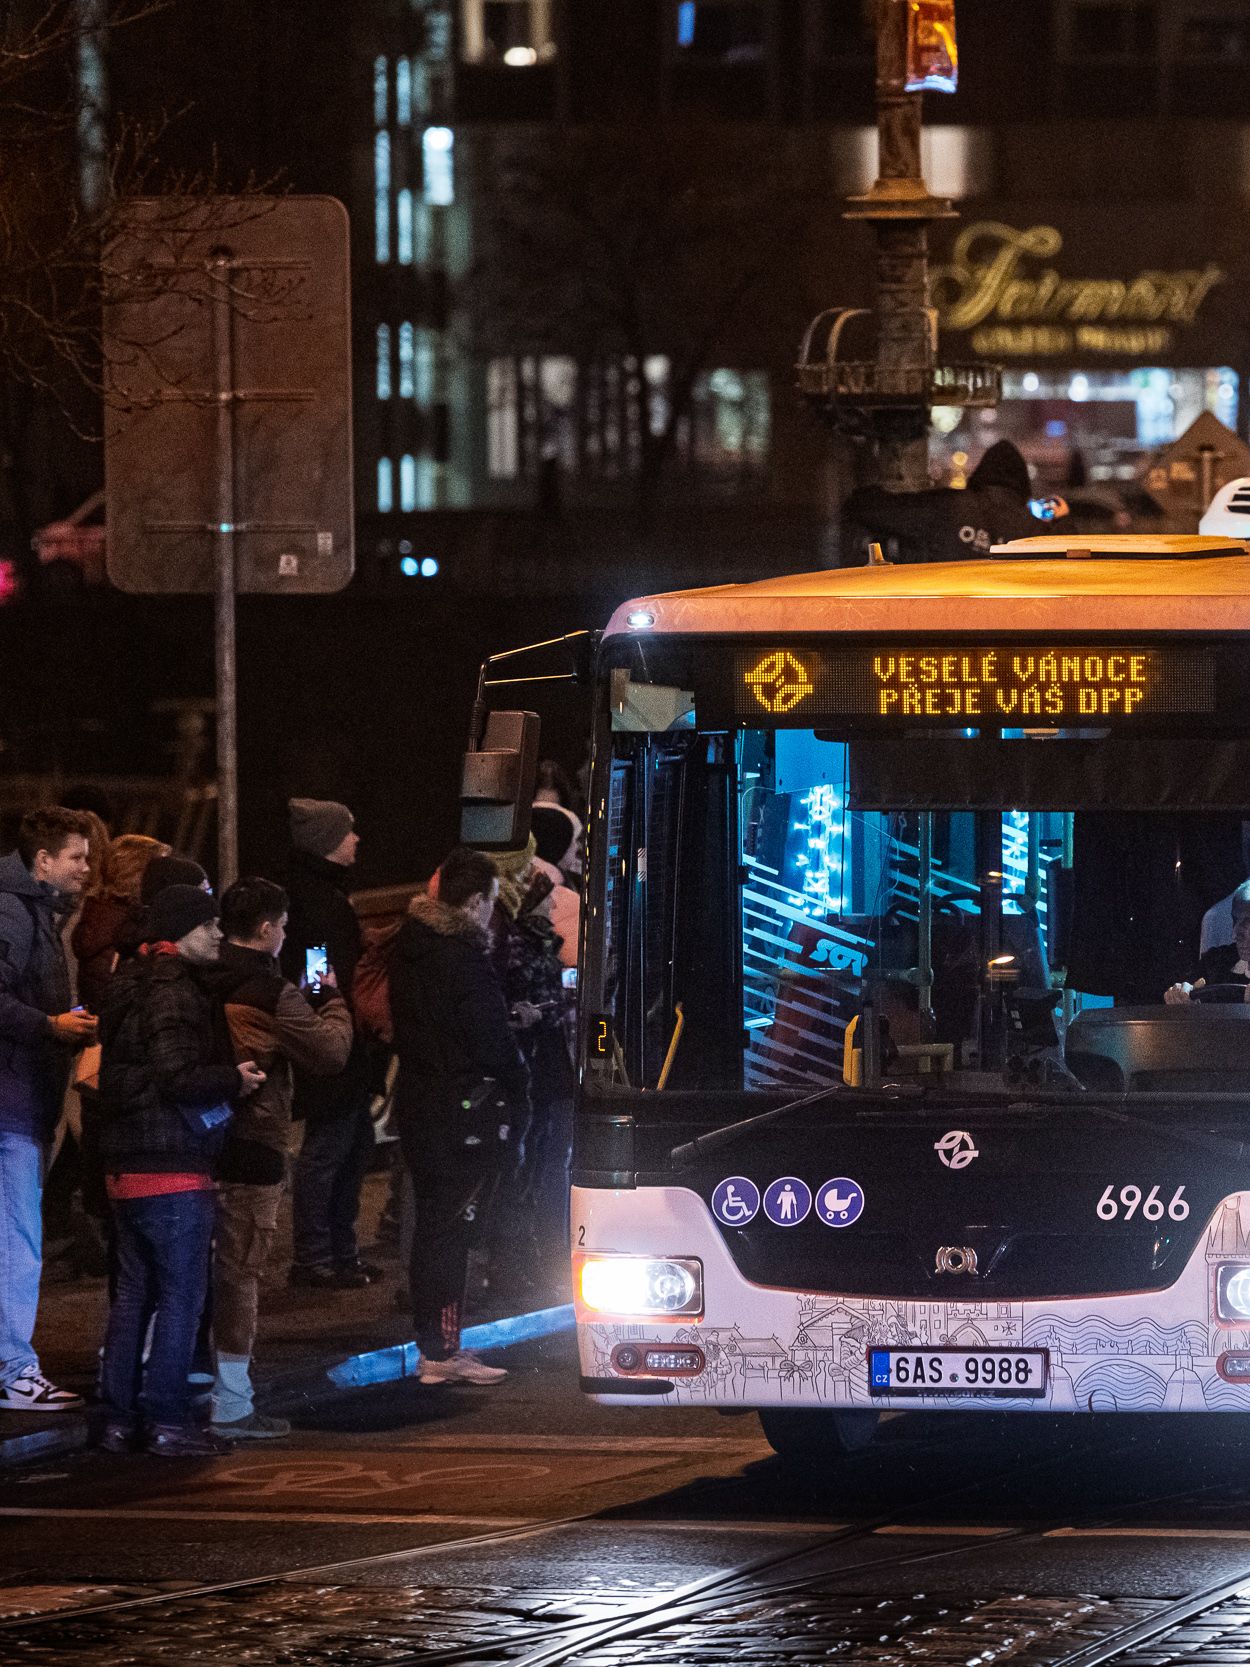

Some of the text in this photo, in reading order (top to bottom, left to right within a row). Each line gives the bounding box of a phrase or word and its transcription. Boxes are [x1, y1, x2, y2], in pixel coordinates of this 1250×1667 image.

[874, 651, 1146, 682] VESELÉ VÁNOCE
[880, 684, 1143, 714] PŘEJE VÁŠ DPP
[598, 1021, 607, 1051] 2
[1096, 1184, 1190, 1221] 6966
[578, 1225, 586, 1246] 2
[875, 1374, 888, 1383] CZ
[895, 1356, 1030, 1385] 6AS 9988
